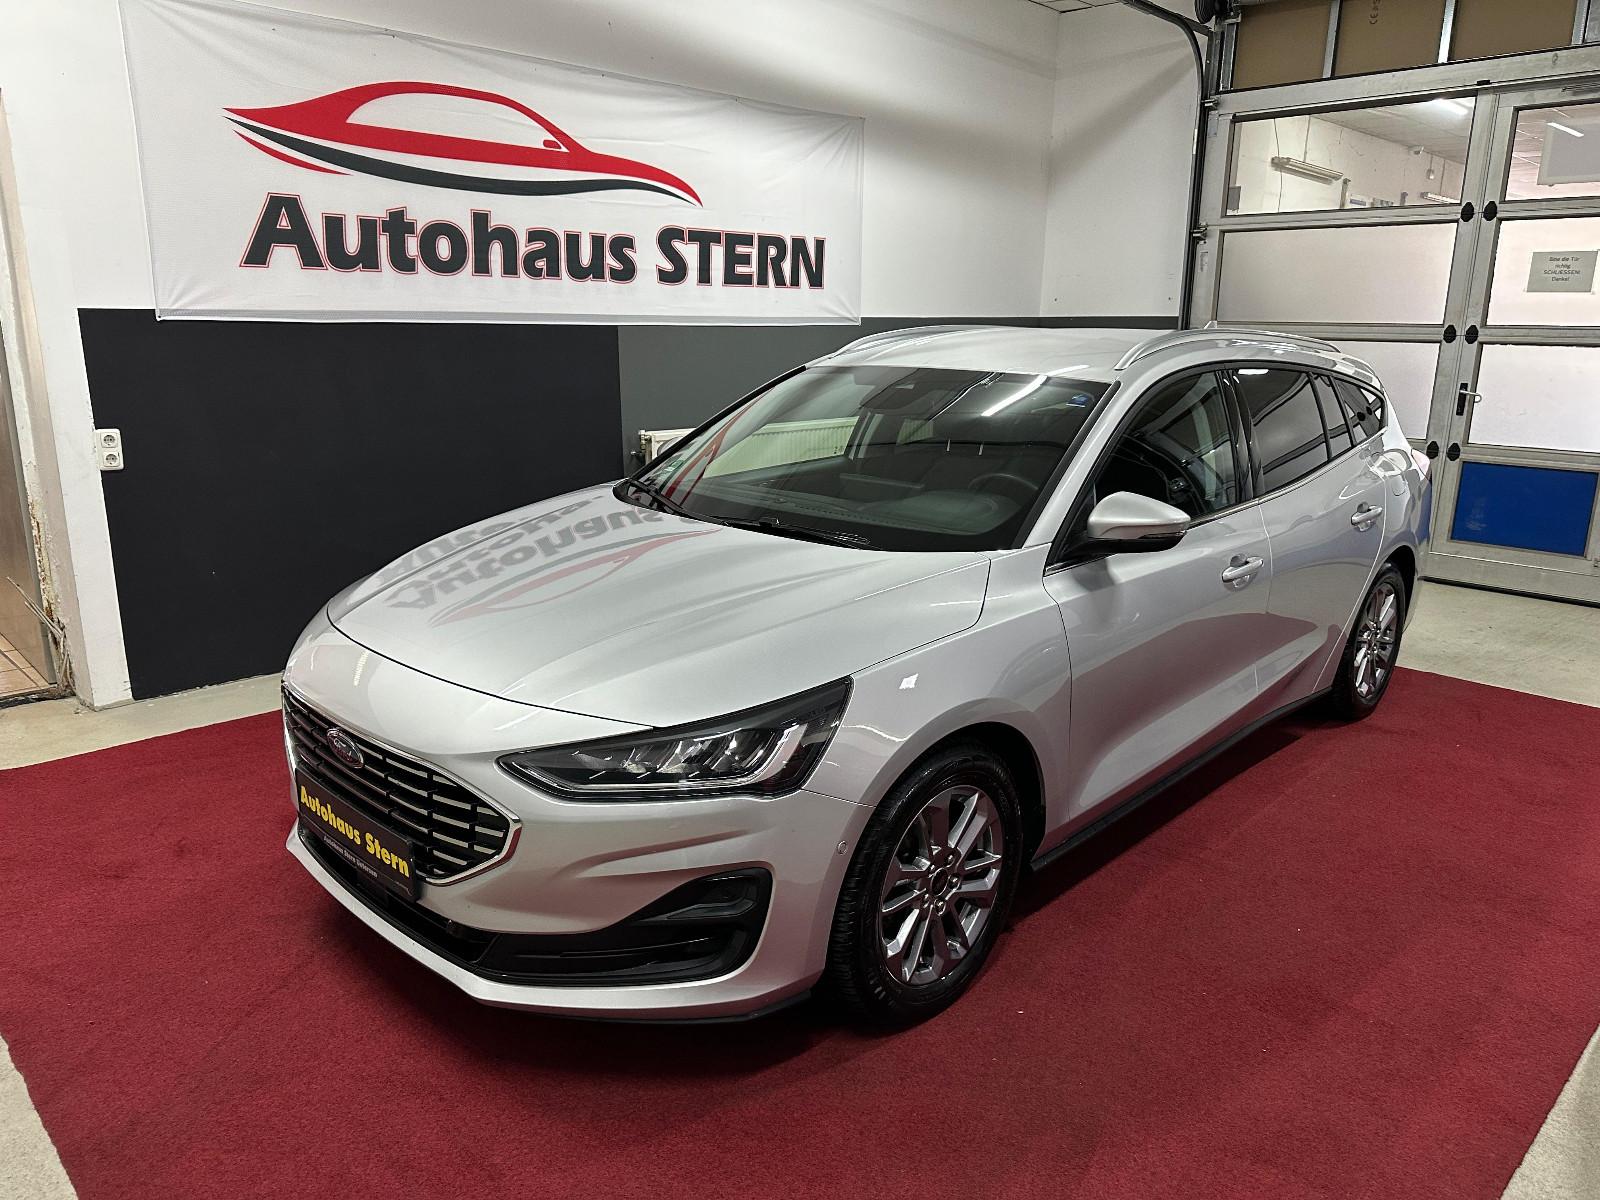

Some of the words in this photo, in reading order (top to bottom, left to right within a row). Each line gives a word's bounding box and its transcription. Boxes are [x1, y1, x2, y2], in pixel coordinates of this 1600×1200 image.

[239, 192, 637, 284] Autohaus
[655, 225, 826, 289] STERN
[300, 785, 361, 845] Autohaus
[365, 832, 410, 878] Stern
